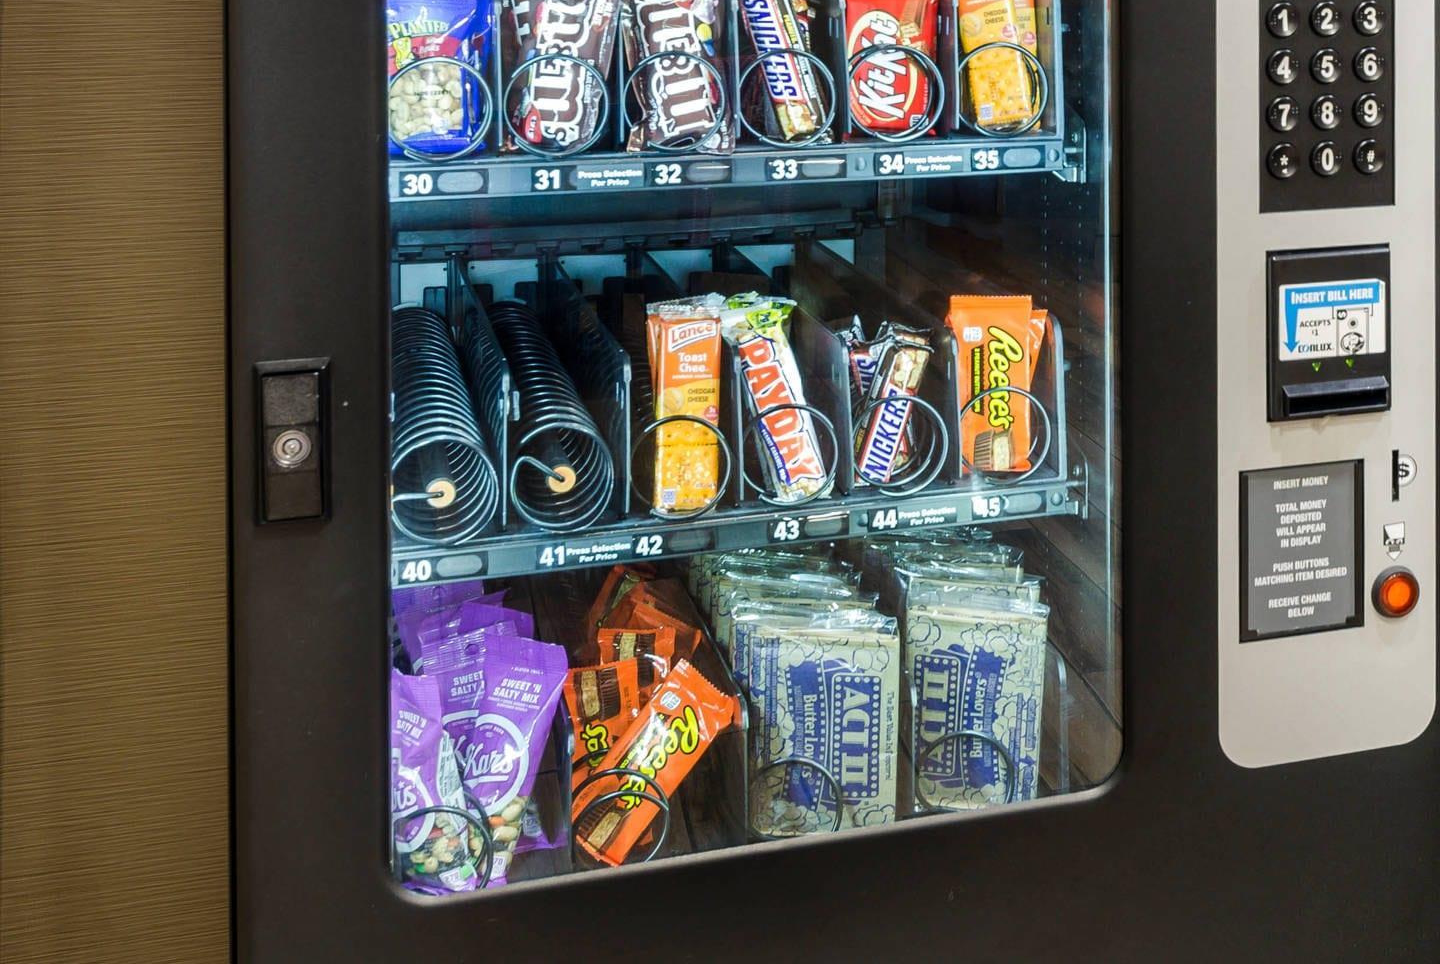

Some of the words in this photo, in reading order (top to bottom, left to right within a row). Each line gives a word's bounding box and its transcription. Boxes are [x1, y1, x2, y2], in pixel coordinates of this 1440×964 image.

[1277, 9, 1289, 32] 1
[1320, 7, 1333, 30] 2
[1363, 6, 1377, 30] 3
[1277, 55, 1291, 79] 4
[1321, 55, 1334, 78] 5
[1363, 53, 1377, 77] 6
[1278, 104, 1291, 127] 7
[1321, 101, 1334, 125] 8
[1363, 99, 1378, 123] 9
[771, 158, 799, 180] 33
[879, 154, 904, 175] 34
[973, 150, 999, 170] 35
[1321, 148, 1334, 172] 0
[534, 169, 561, 190] 31
[603, 167, 643, 178] Selection
[608, 177, 630, 187] Price
[654, 164, 682, 185] 32
[403, 173, 433, 195] 30
[1291, 290, 1326, 305] INSERT
[1327, 288, 1348, 302] BILL
[1349, 287, 1374, 300] HERE
[671, 323, 713, 344] Lance
[1299, 319, 1331, 328] ACCEPTS
[678, 352, 707, 362] Toast
[987, 326, 1024, 430] Reese's
[738, 337, 825, 484] PAYDAY
[1273, 478, 1301, 490] INSERT
[1302, 476, 1329, 487] MONEY
[1275, 502, 1299, 514] TOTAL
[1300, 499, 1327, 510] MONEY
[872, 509, 898, 529] 44
[1280, 511, 1322, 524] DEPOSITED
[773, 518, 800, 540] 43
[1276, 526, 1295, 537] WILL
[1296, 522, 1327, 535] APPEAR
[566, 546, 590, 557] Press
[591, 542, 631, 553] Selection
[635, 535, 663, 556] 42
[1280, 538, 1289, 548] IN
[1290, 535, 1322, 548] DISPLAY
[539, 545, 565, 567] 41
[579, 555, 595, 564] Per
[595, 552, 618, 562] Price
[1272, 561, 1294, 572] PUSH
[1295, 557, 1330, 570] BUTTONS
[401, 560, 432, 582] 40
[1254, 574, 1294, 587] MATCHING
[1295, 570, 1315, 582] ITEM
[1315, 567, 1348, 580] DESIRED
[1268, 595, 1300, 609] RECEIVE
[1301, 592, 1332, 605] CHANGE
[1287, 606, 1315, 619] BELOW
[452, 670, 485, 687] SWEET
[500, 678, 531, 692] SWEET
[923, 667, 949, 703] II
[450, 684, 478, 697] SALTY
[492, 687, 520, 699] SALTY
[521, 692, 541, 704] MIX
[969, 678, 987, 717] Lovers
[802, 694, 818, 736] Butter
[842, 686, 870, 748] ACT
[920, 706, 946, 764] ACT
[619, 706, 701, 810] Reese's
[801, 737, 818, 779] Lovrs
[841, 752, 869, 787] II
